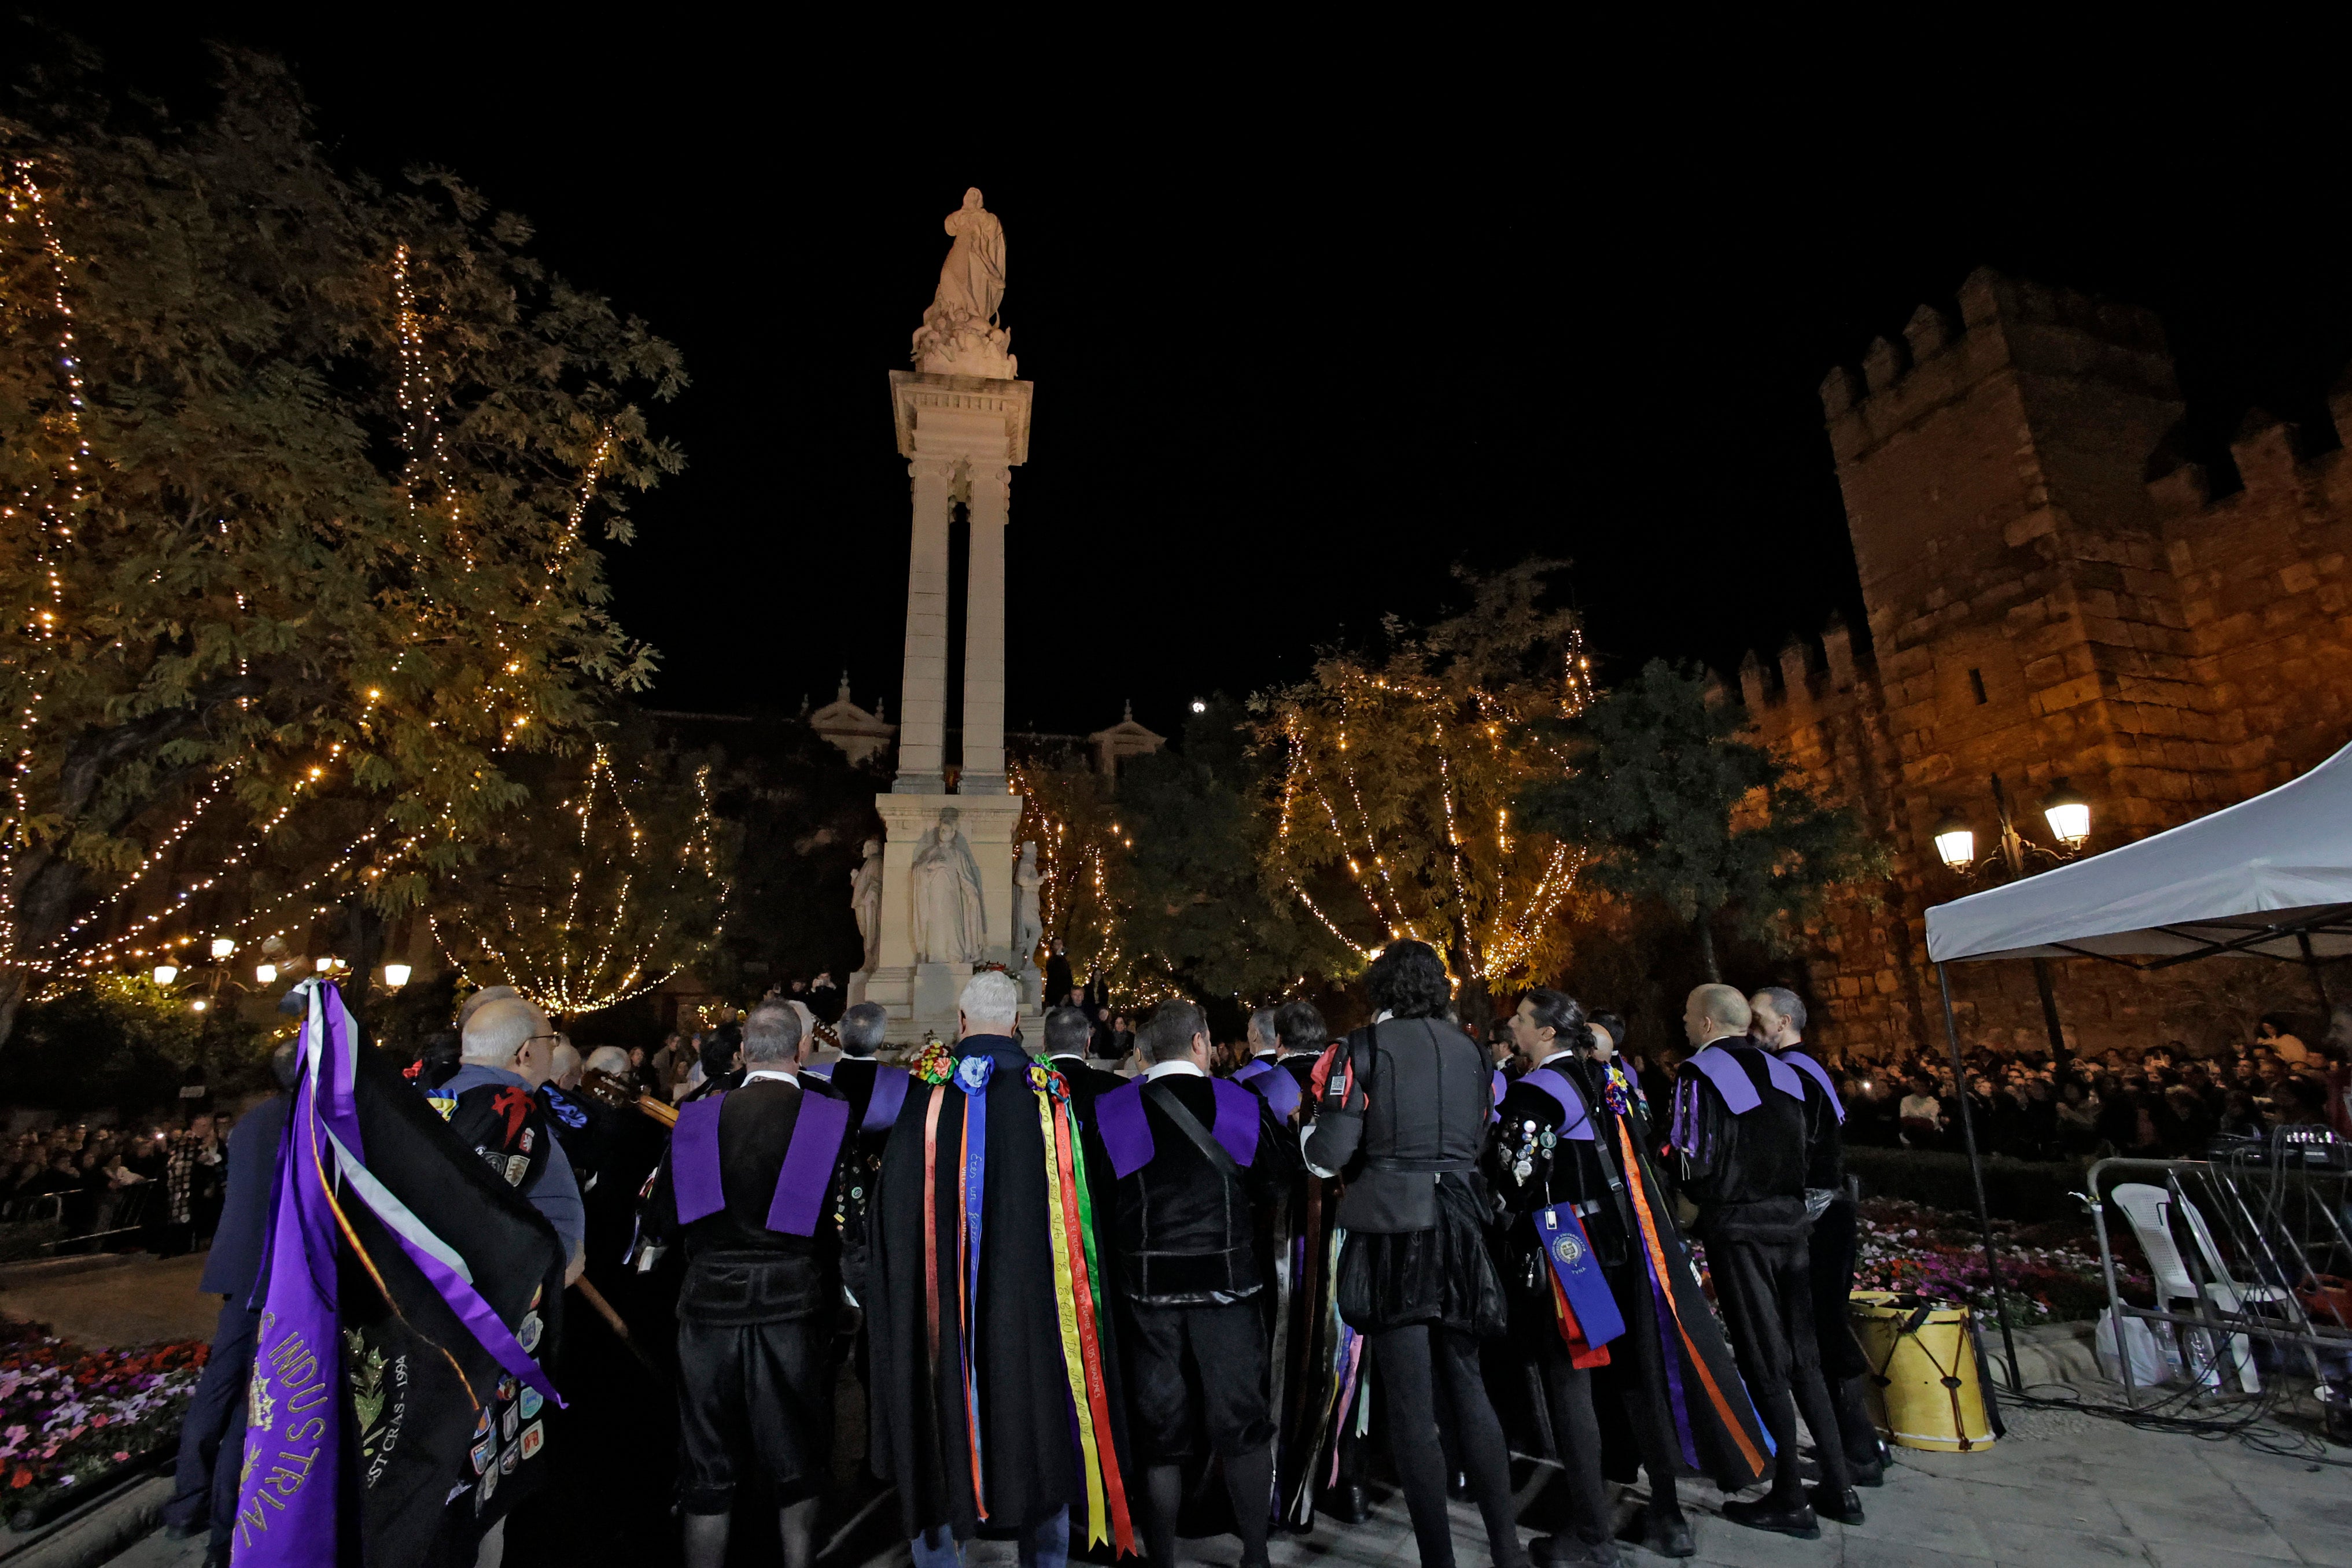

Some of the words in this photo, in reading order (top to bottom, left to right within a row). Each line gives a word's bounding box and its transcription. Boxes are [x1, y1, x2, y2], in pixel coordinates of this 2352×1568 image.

[1041, 1100, 1049, 1123] NO
[969, 1153, 983, 1179] Eres
[969, 1186, 977, 1202] un
[1052, 1213, 1064, 1239] YA
[1055, 1246, 1068, 1272] TE
[1078, 1279, 1083, 1288] EL
[1057, 1285, 1074, 1333] ECHO
[1081, 1305, 1091, 1331] GRANDE
[1066, 1340, 1078, 1358] DE
[1086, 1334, 1093, 1342] DE
[1087, 1344, 1096, 1359] LOS
[383, 1403, 405, 1452] CRAS
[395, 1355, 408, 1387] 1994
